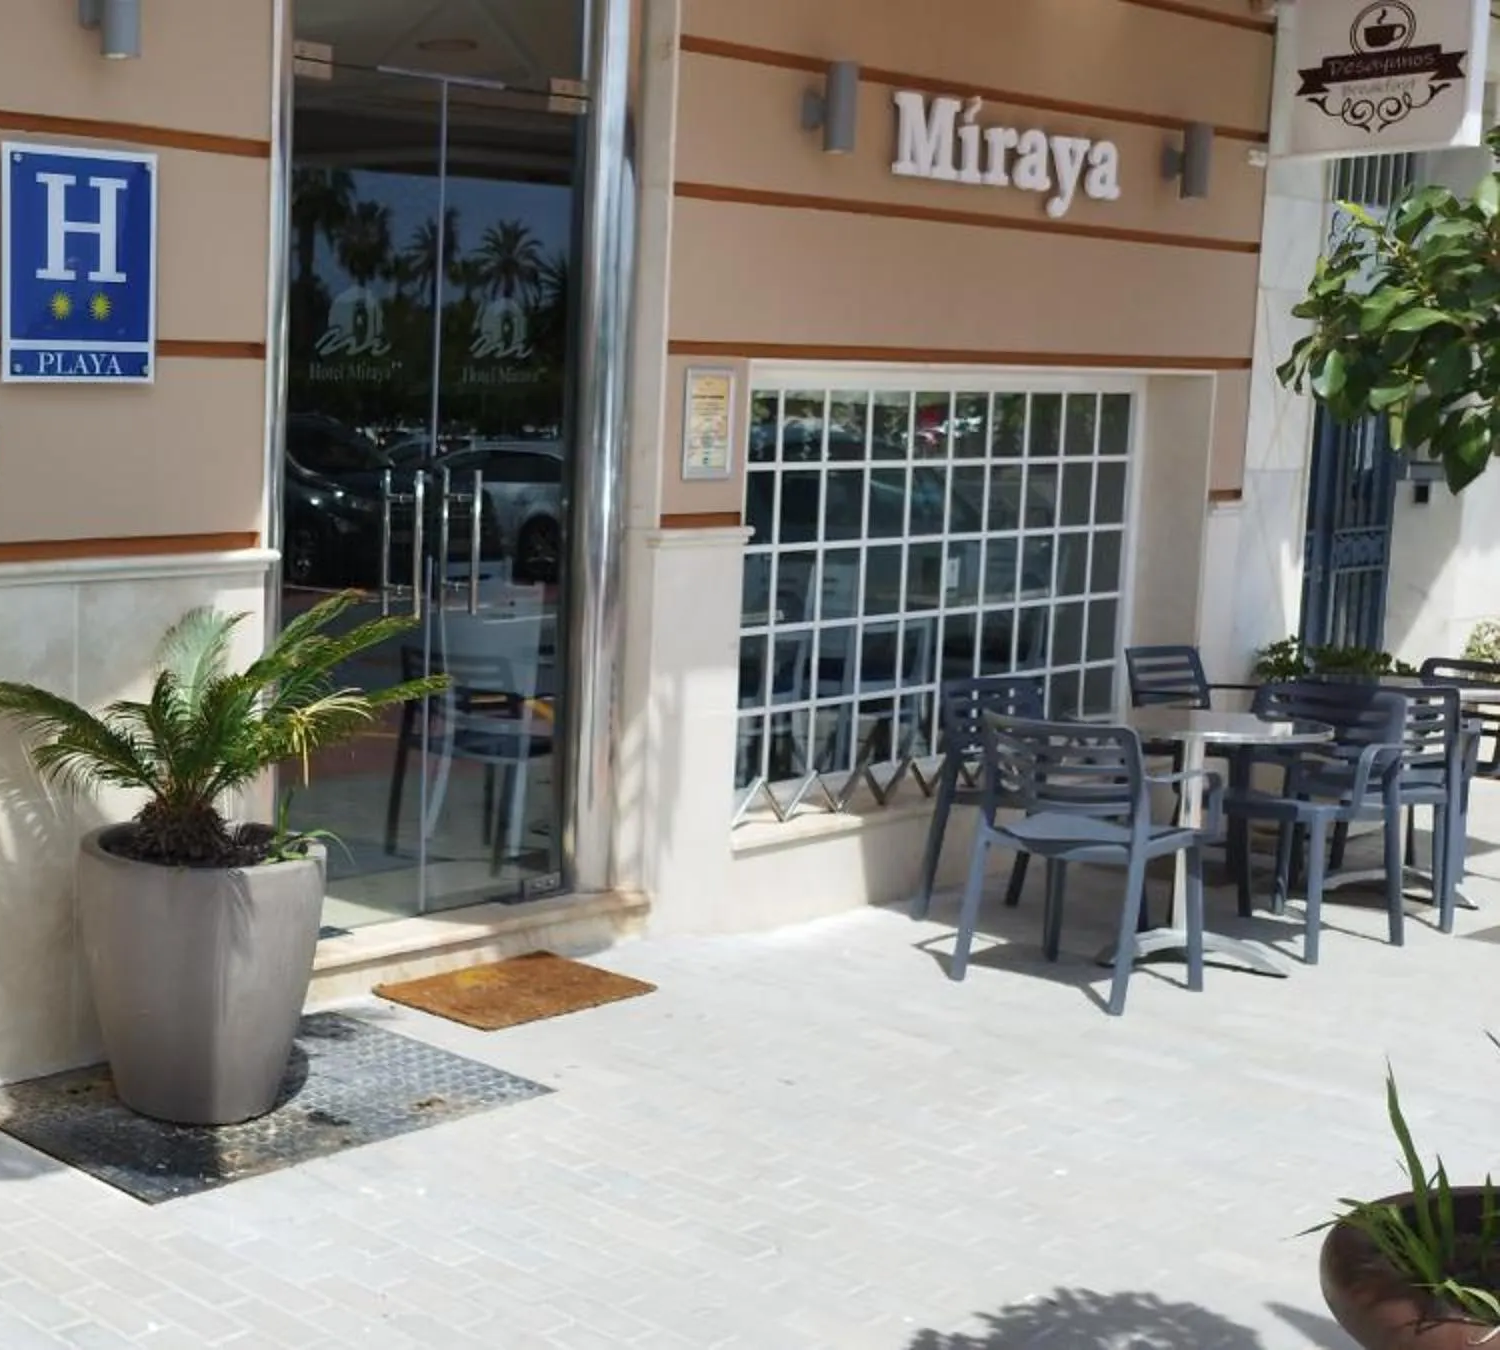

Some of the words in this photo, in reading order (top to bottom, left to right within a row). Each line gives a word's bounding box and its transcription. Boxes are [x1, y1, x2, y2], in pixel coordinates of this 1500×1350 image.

[892, 91, 1121, 218] Míraya
[35, 171, 129, 283] H
[37, 351, 123, 376] PLAYA
